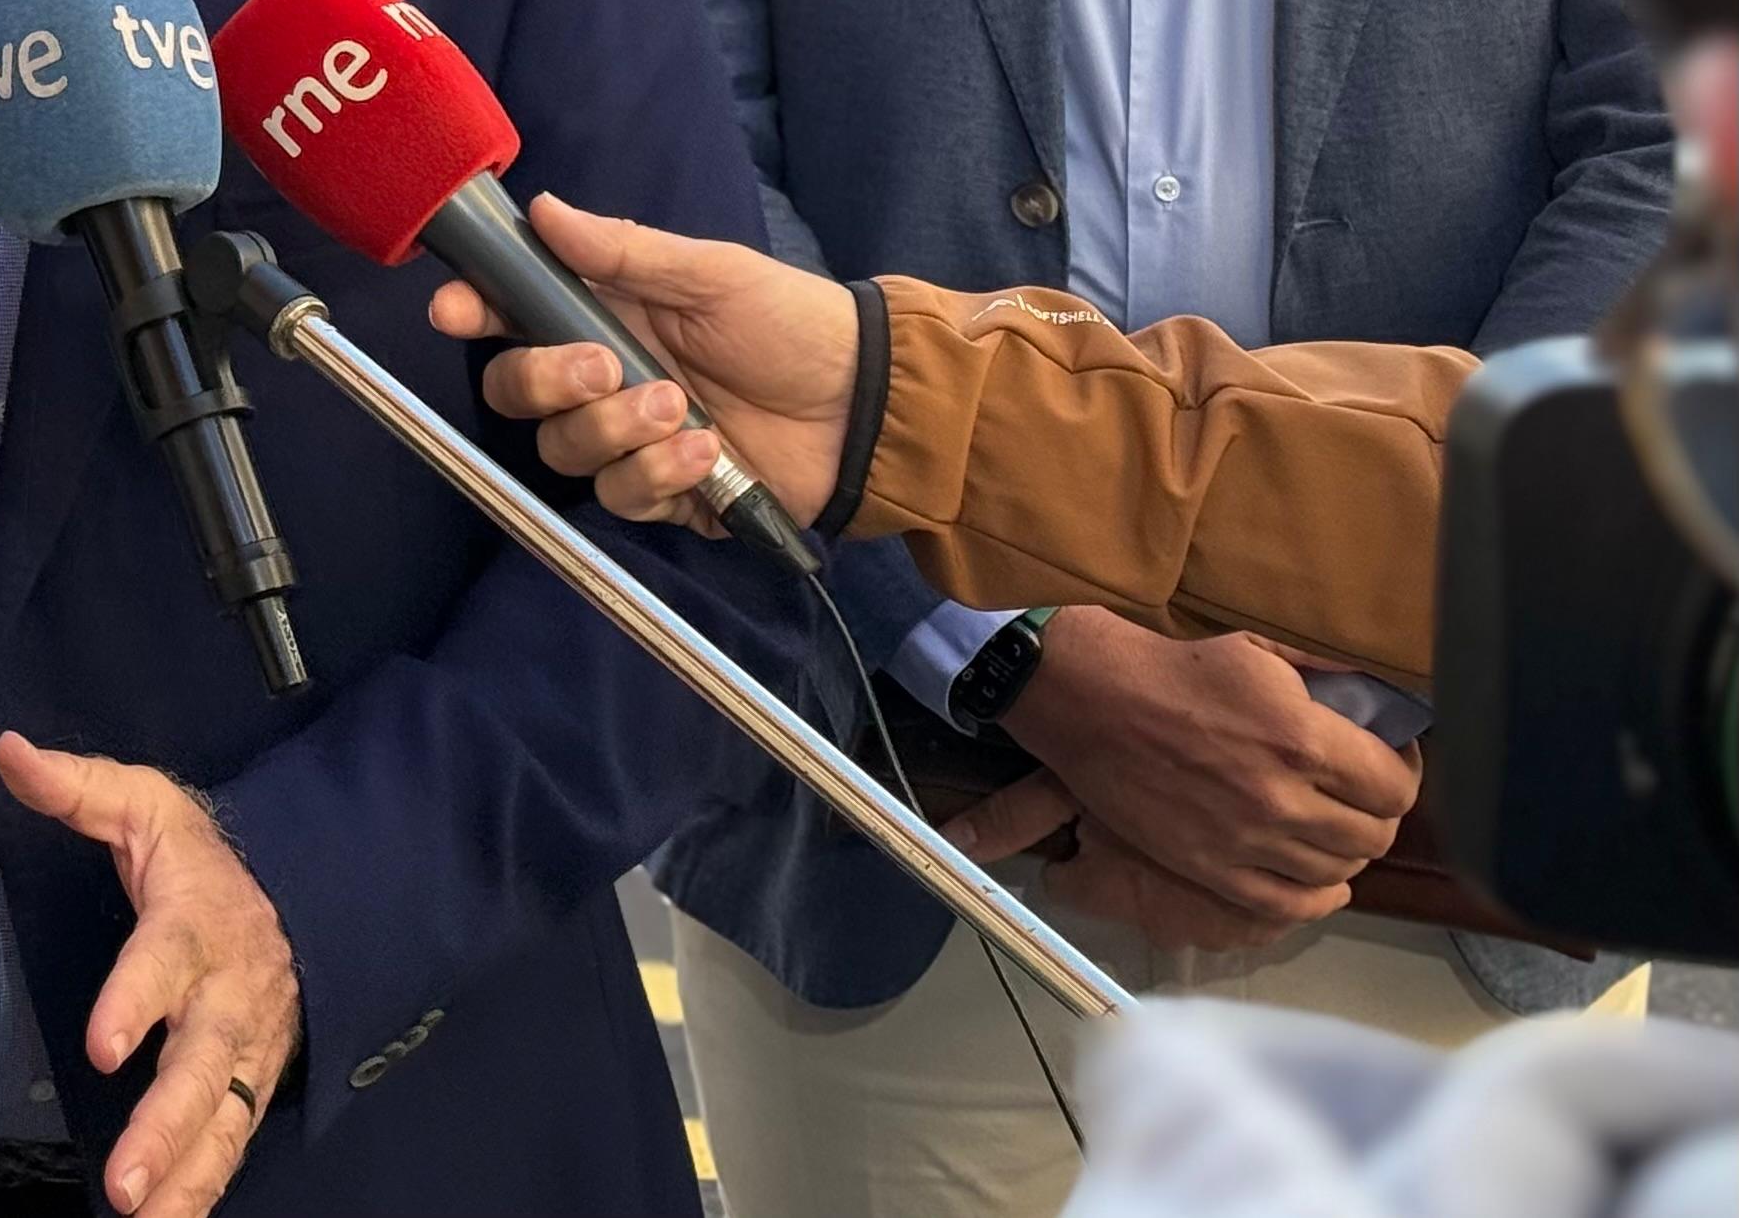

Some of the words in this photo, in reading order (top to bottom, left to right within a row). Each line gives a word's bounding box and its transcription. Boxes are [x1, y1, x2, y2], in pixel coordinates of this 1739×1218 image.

[113, 5, 214, 90] tve
[381, 1, 446, 42] rn
[262, 40, 388, 158] rne
